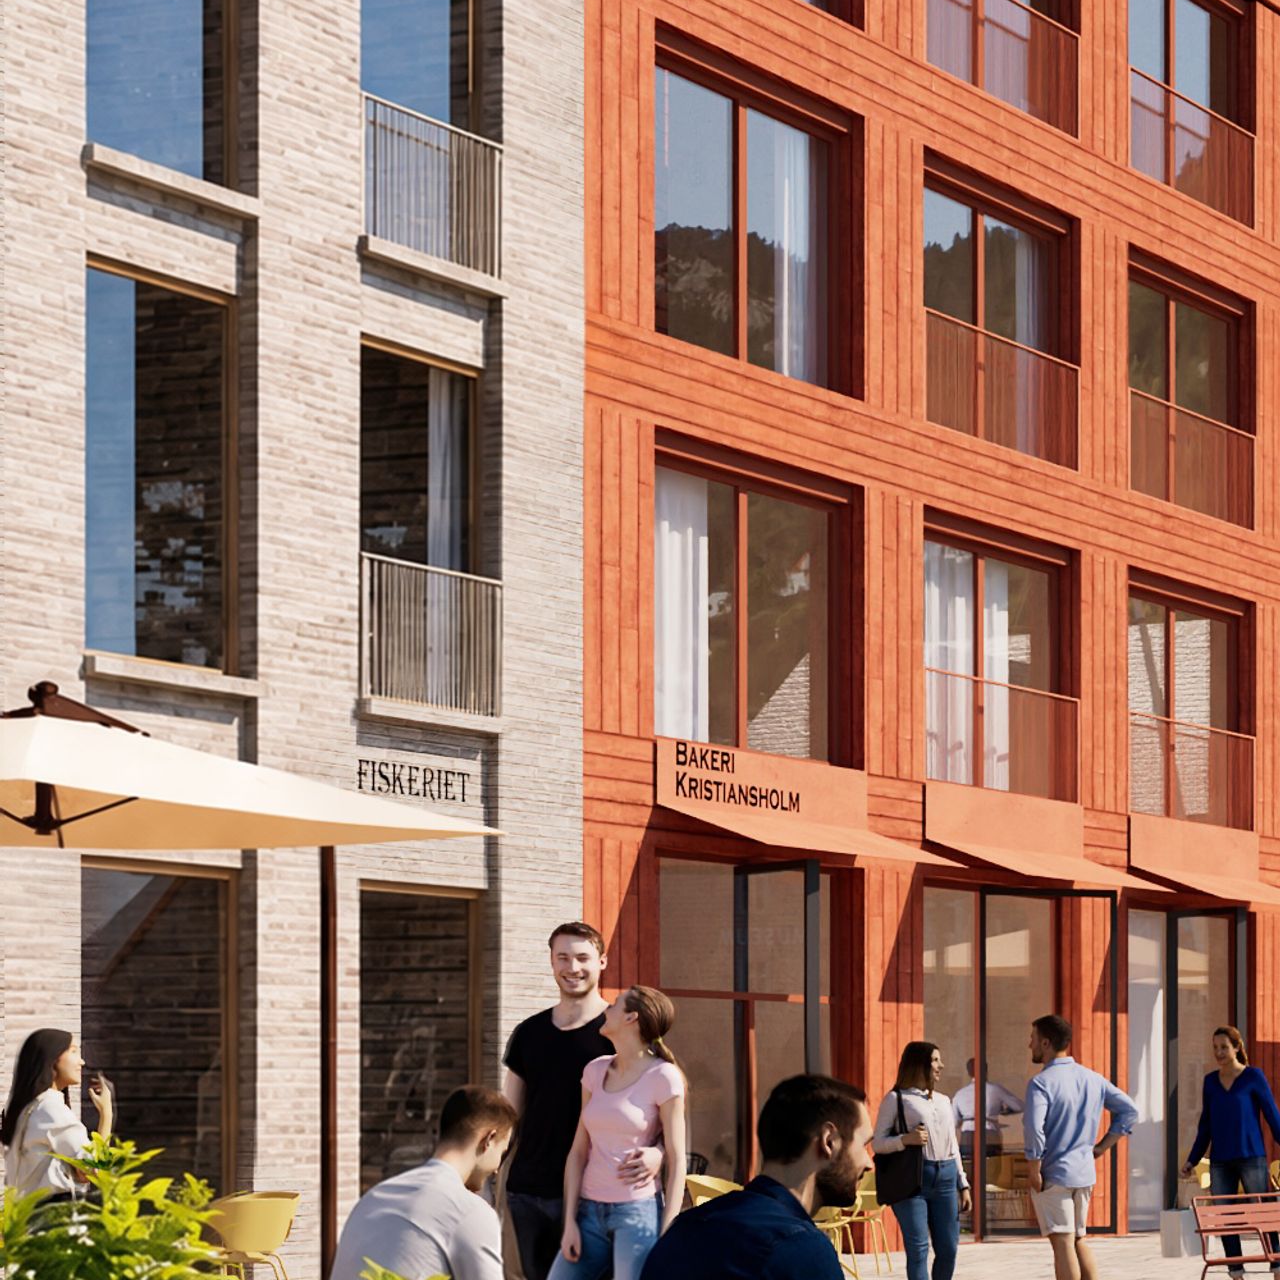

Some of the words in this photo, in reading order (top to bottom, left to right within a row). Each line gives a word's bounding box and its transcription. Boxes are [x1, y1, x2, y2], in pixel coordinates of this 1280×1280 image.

[675, 742, 735, 774] BAKERI
[357, 759, 470, 802] FISKERIET
[675, 771, 800, 813] KRISTIANSHOLM
